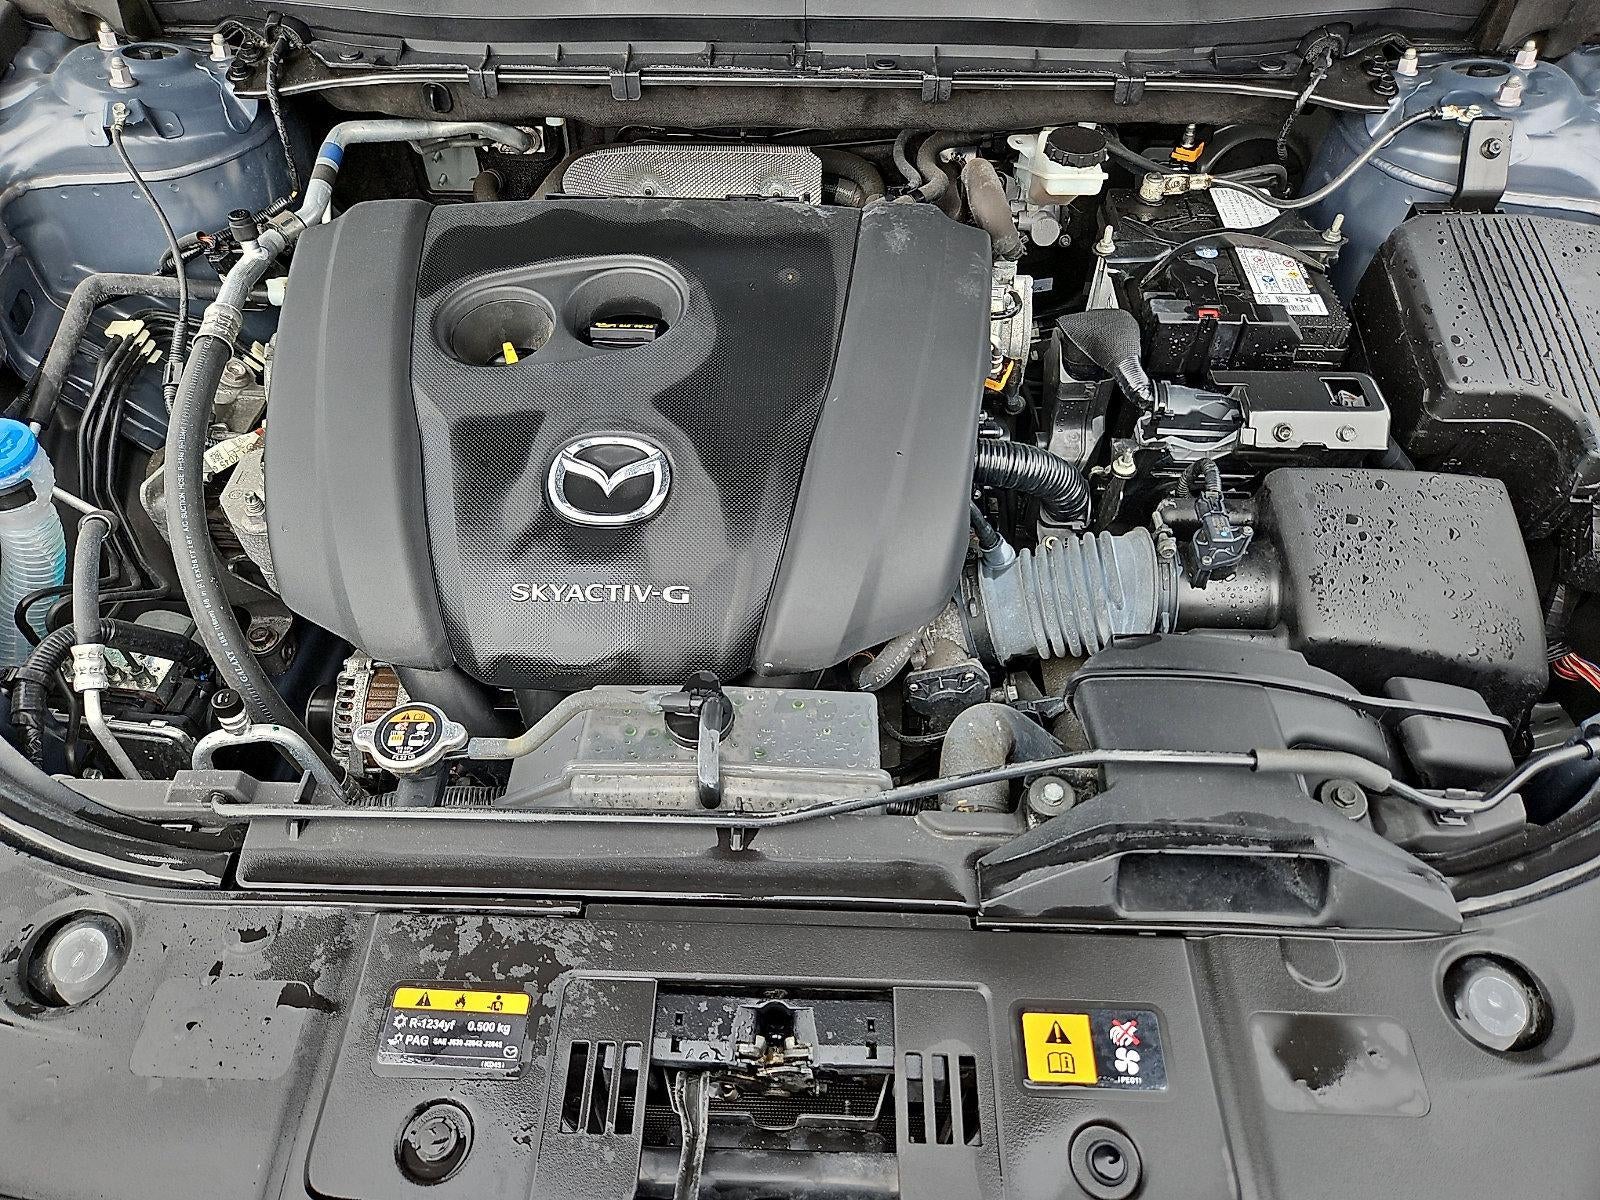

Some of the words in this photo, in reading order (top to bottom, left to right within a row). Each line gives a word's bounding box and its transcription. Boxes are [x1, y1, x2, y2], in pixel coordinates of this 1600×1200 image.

[179, 492, 187, 519] SUCTION
[510, 583, 691, 604] SKYACTIV-G
[224, 649, 248, 683] GALAXY
[409, 1017, 456, 1032] R-1234yf
[467, 1020, 496, 1033] 0.500
[497, 1022, 511, 1035] kg
[404, 1034, 430, 1046] PAG
